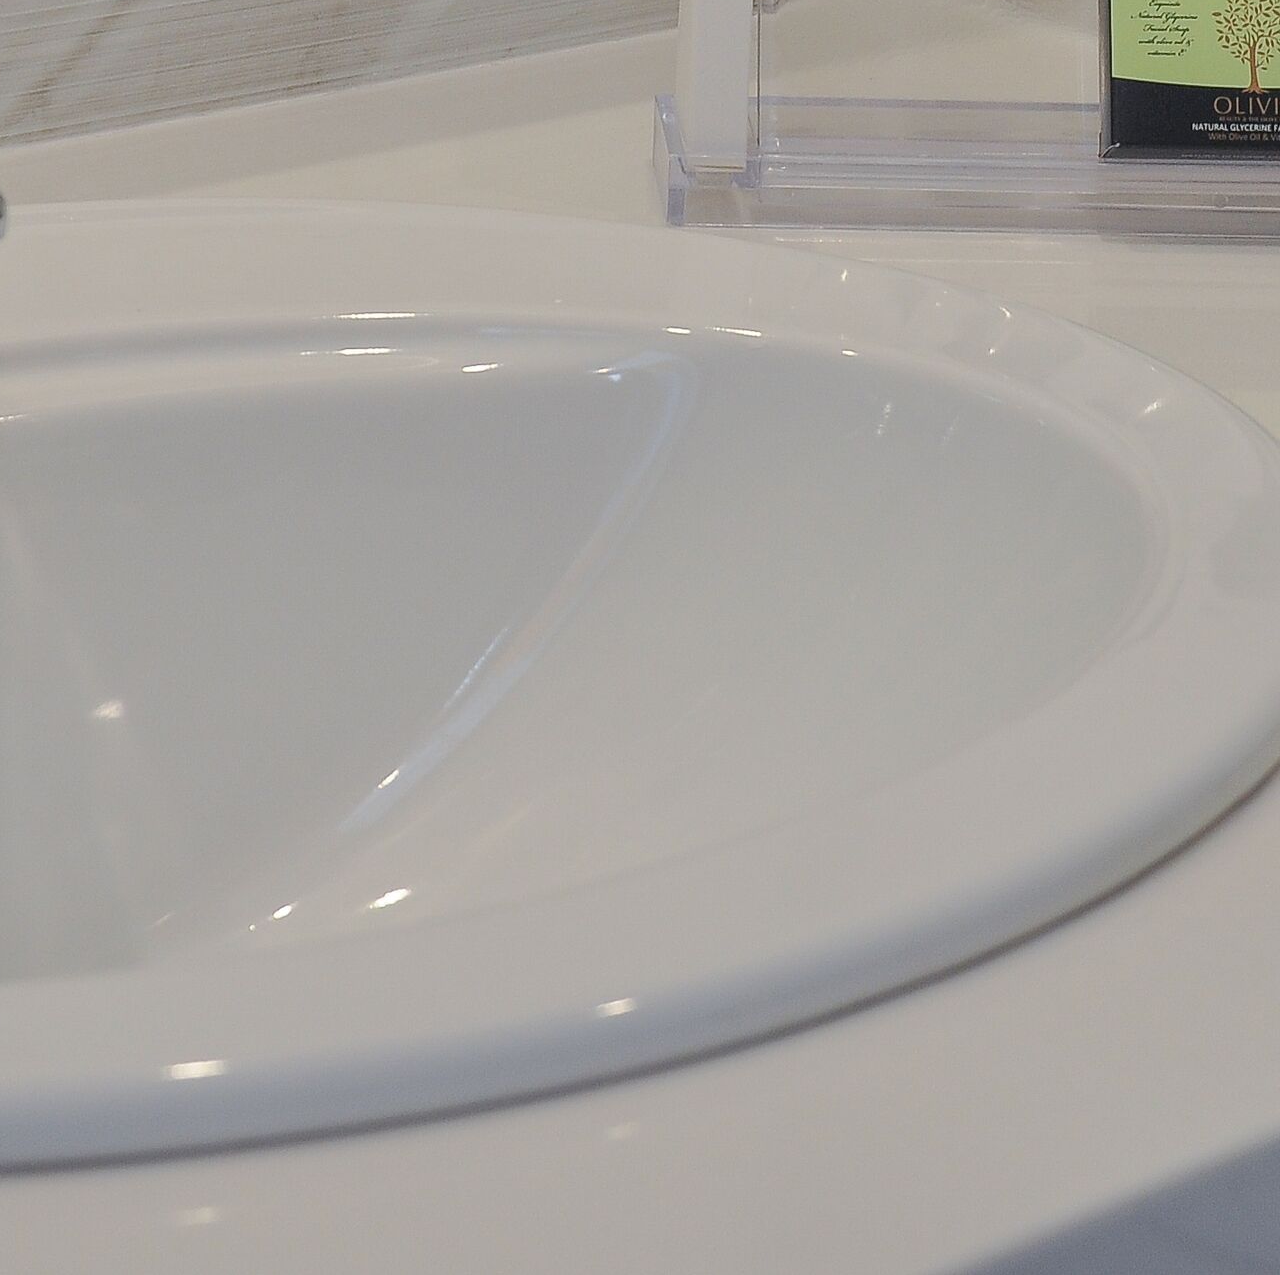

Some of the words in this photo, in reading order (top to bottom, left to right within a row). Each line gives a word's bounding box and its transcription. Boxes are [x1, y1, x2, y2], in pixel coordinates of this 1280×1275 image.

[1191, 122, 1230, 132] NATURAL
[1230, 123, 1272, 133] GLYCERINE
[1208, 132, 1227, 141] With
[1228, 132, 1249, 142] Olive
[1249, 132, 1262, 142] Oil
[1262, 133, 1270, 142] &
